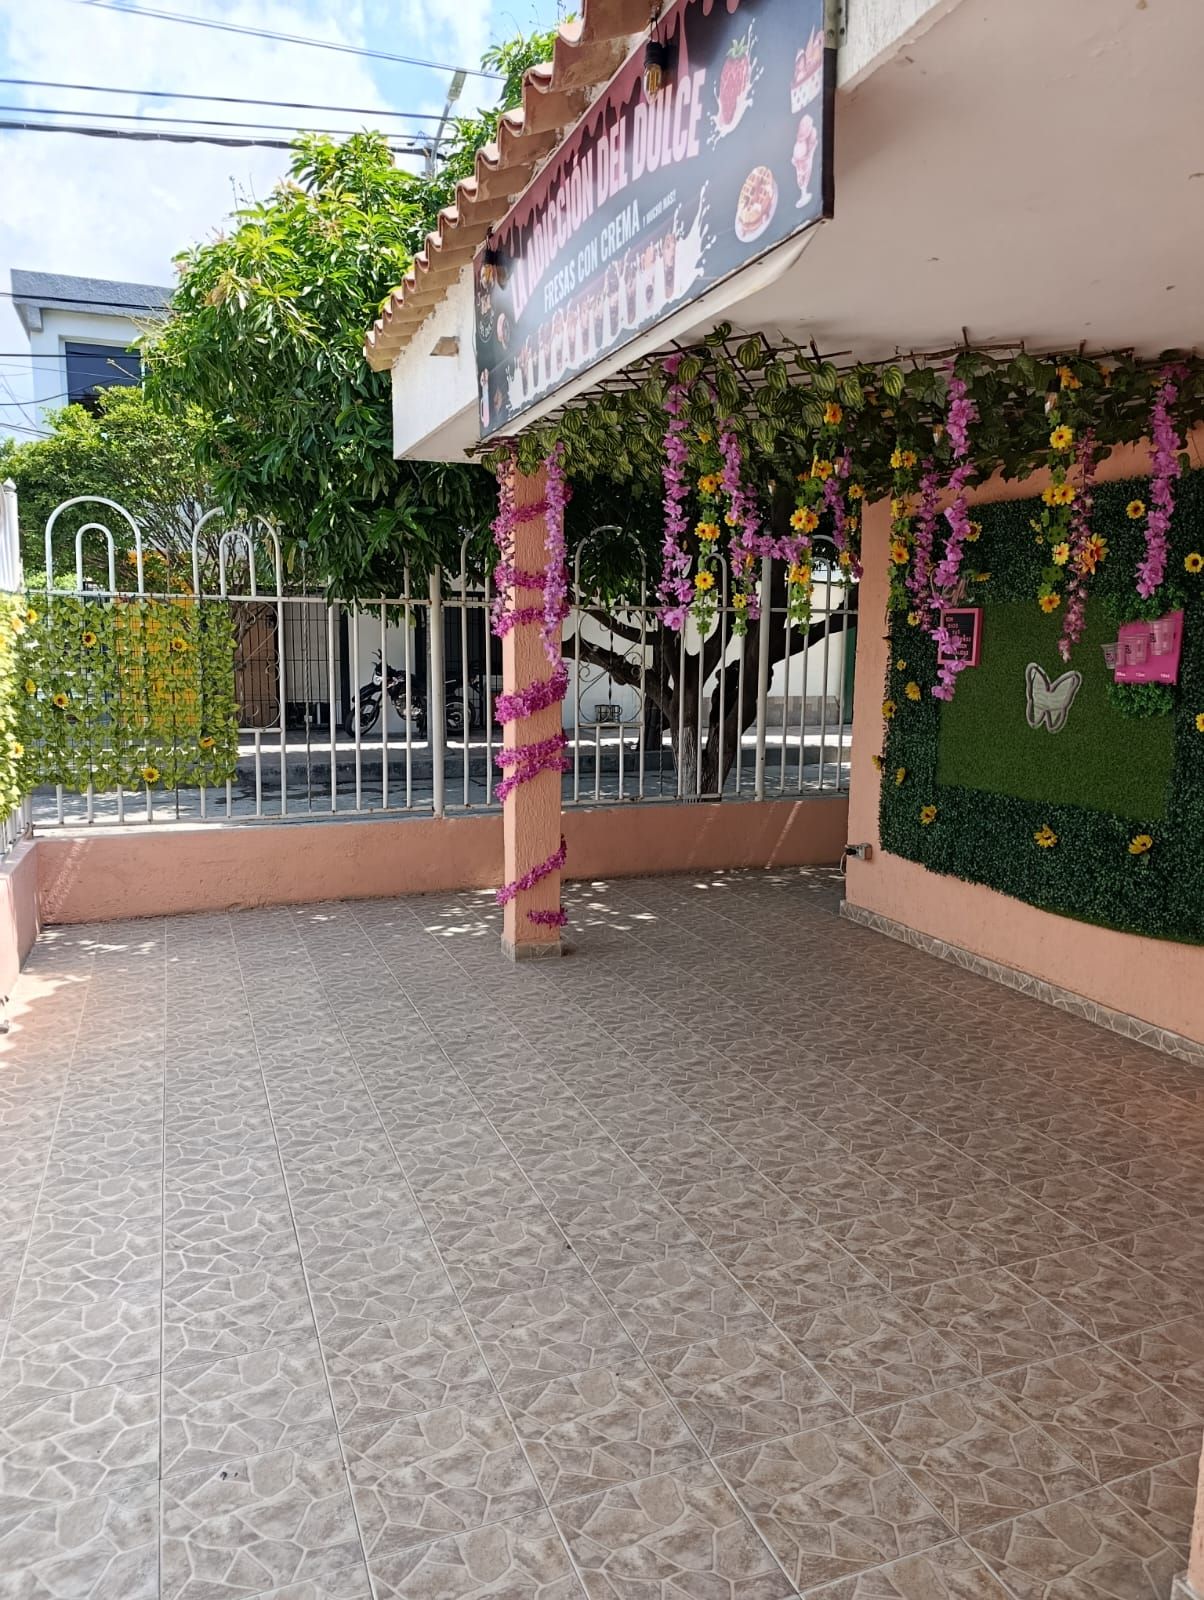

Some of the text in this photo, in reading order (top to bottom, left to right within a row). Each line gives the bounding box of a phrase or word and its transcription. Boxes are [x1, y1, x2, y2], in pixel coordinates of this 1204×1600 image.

[510, 67, 706, 324] LA ADICCIÓN DEL DULCE
[543, 259, 575, 313] FRESAS
[577, 237, 598, 283] CON
[600, 199, 640, 262] CREMA
